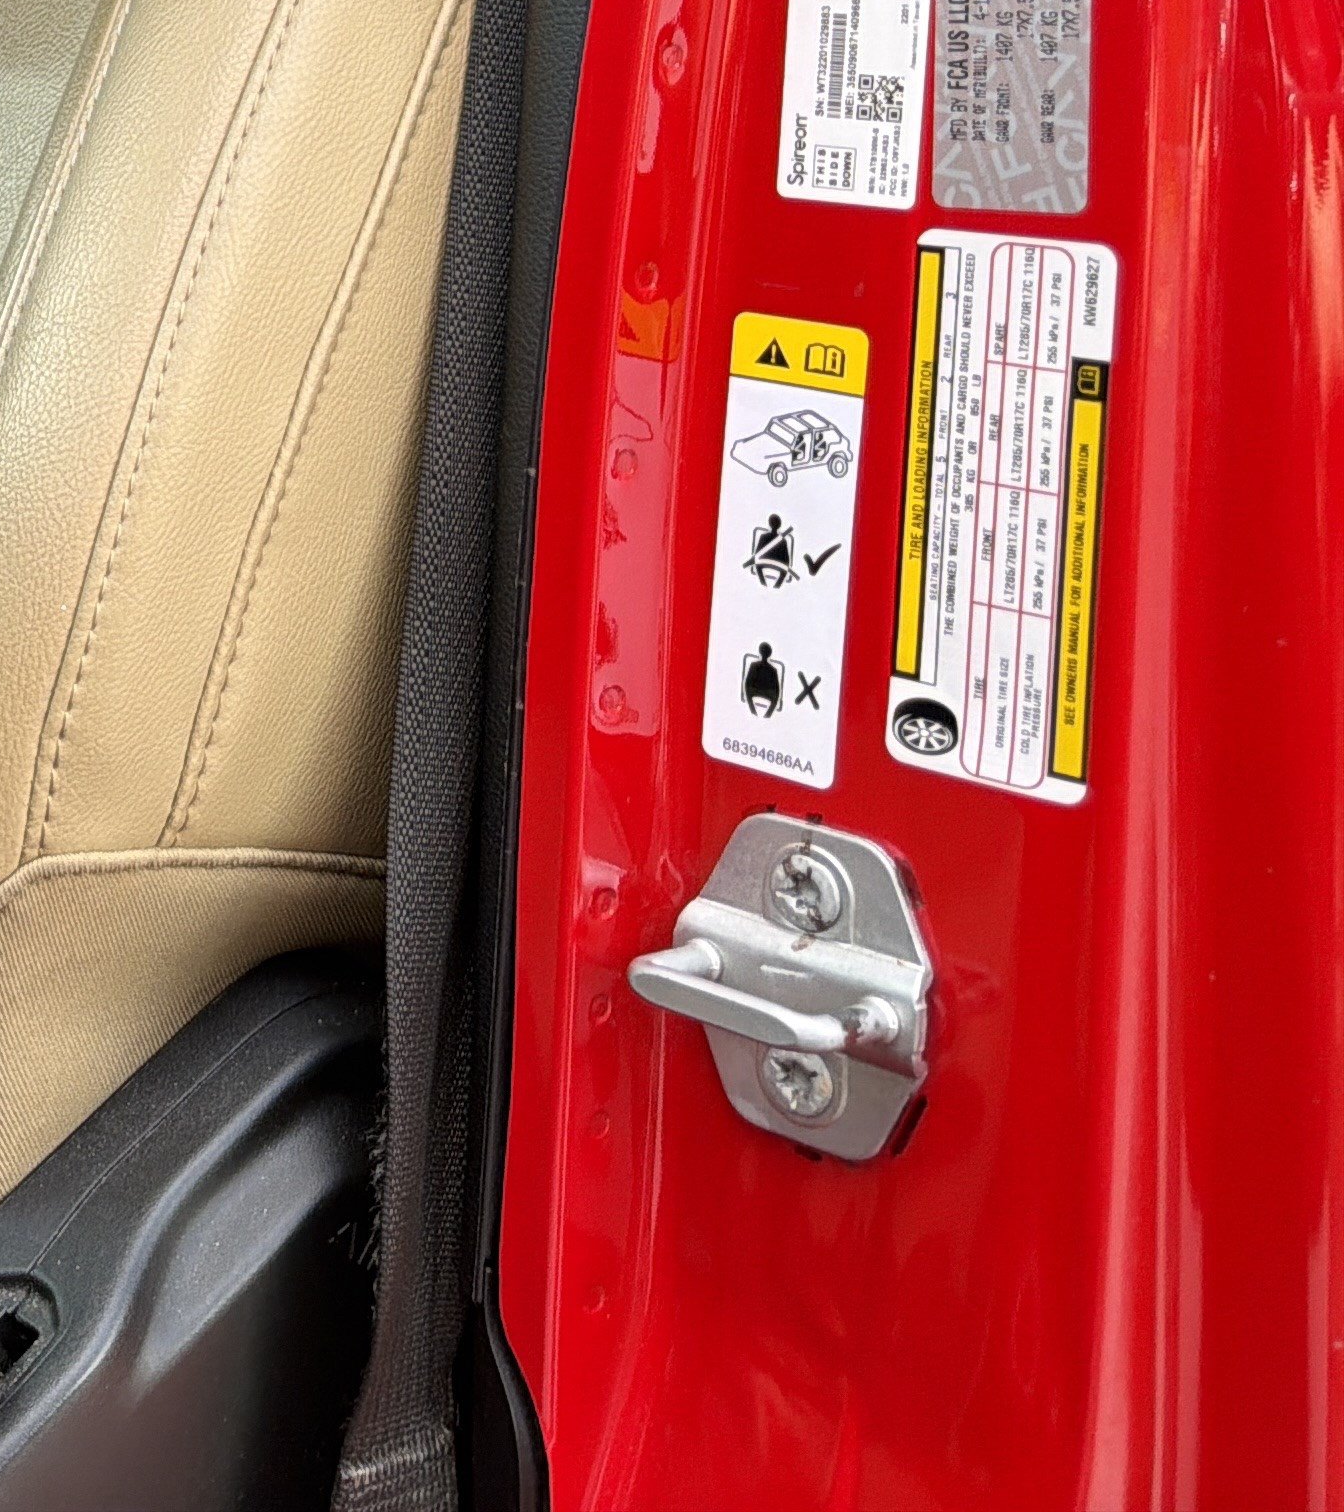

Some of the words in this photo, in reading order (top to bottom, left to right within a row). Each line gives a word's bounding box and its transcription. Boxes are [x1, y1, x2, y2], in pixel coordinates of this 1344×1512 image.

[996, 11, 1012, 26] KG
[1041, 11, 1058, 26] KG
[948, 31, 968, 52] US
[947, 60, 968, 89] FCA
[951, 98, 967, 112] BY
[787, 113, 807, 186] Spireon
[816, 149, 826, 185] THIS
[829, 151, 839, 186] SIDE
[842, 152, 852, 187] DOWN
[963, 253, 975, 292] EXCEED
[946, 291, 958, 299] 3
[1083, 256, 1101, 327] KW629627
[961, 295, 973, 329] NEVER
[959, 332, 970, 372] SHOULD
[941, 375, 952, 383] 2
[956, 375, 968, 410] CARGO
[917, 360, 932, 443] INFORMATION
[955, 413, 965, 434] AND
[913, 448, 927, 501] LOADING
[951, 438, 964, 498] OCCUPANTS
[966, 469, 976, 483] KG
[1073, 443, 1089, 516] INFORMATION
[911, 504, 924, 529] AND
[950, 502, 960, 514] OF
[909, 534, 922, 559] TIRE
[947, 518, 959, 556] WEIGHT
[1070, 521, 1084, 582] ADDITIONAL
[945, 561, 957, 613] COMBINED
[1070, 586, 1081, 606] FOR
[944, 616, 954, 636] THE
[1067, 613, 1080, 655] MANUAL
[1063, 706, 1076, 725] SEE
[722, 738, 815, 776] 68394686AA
